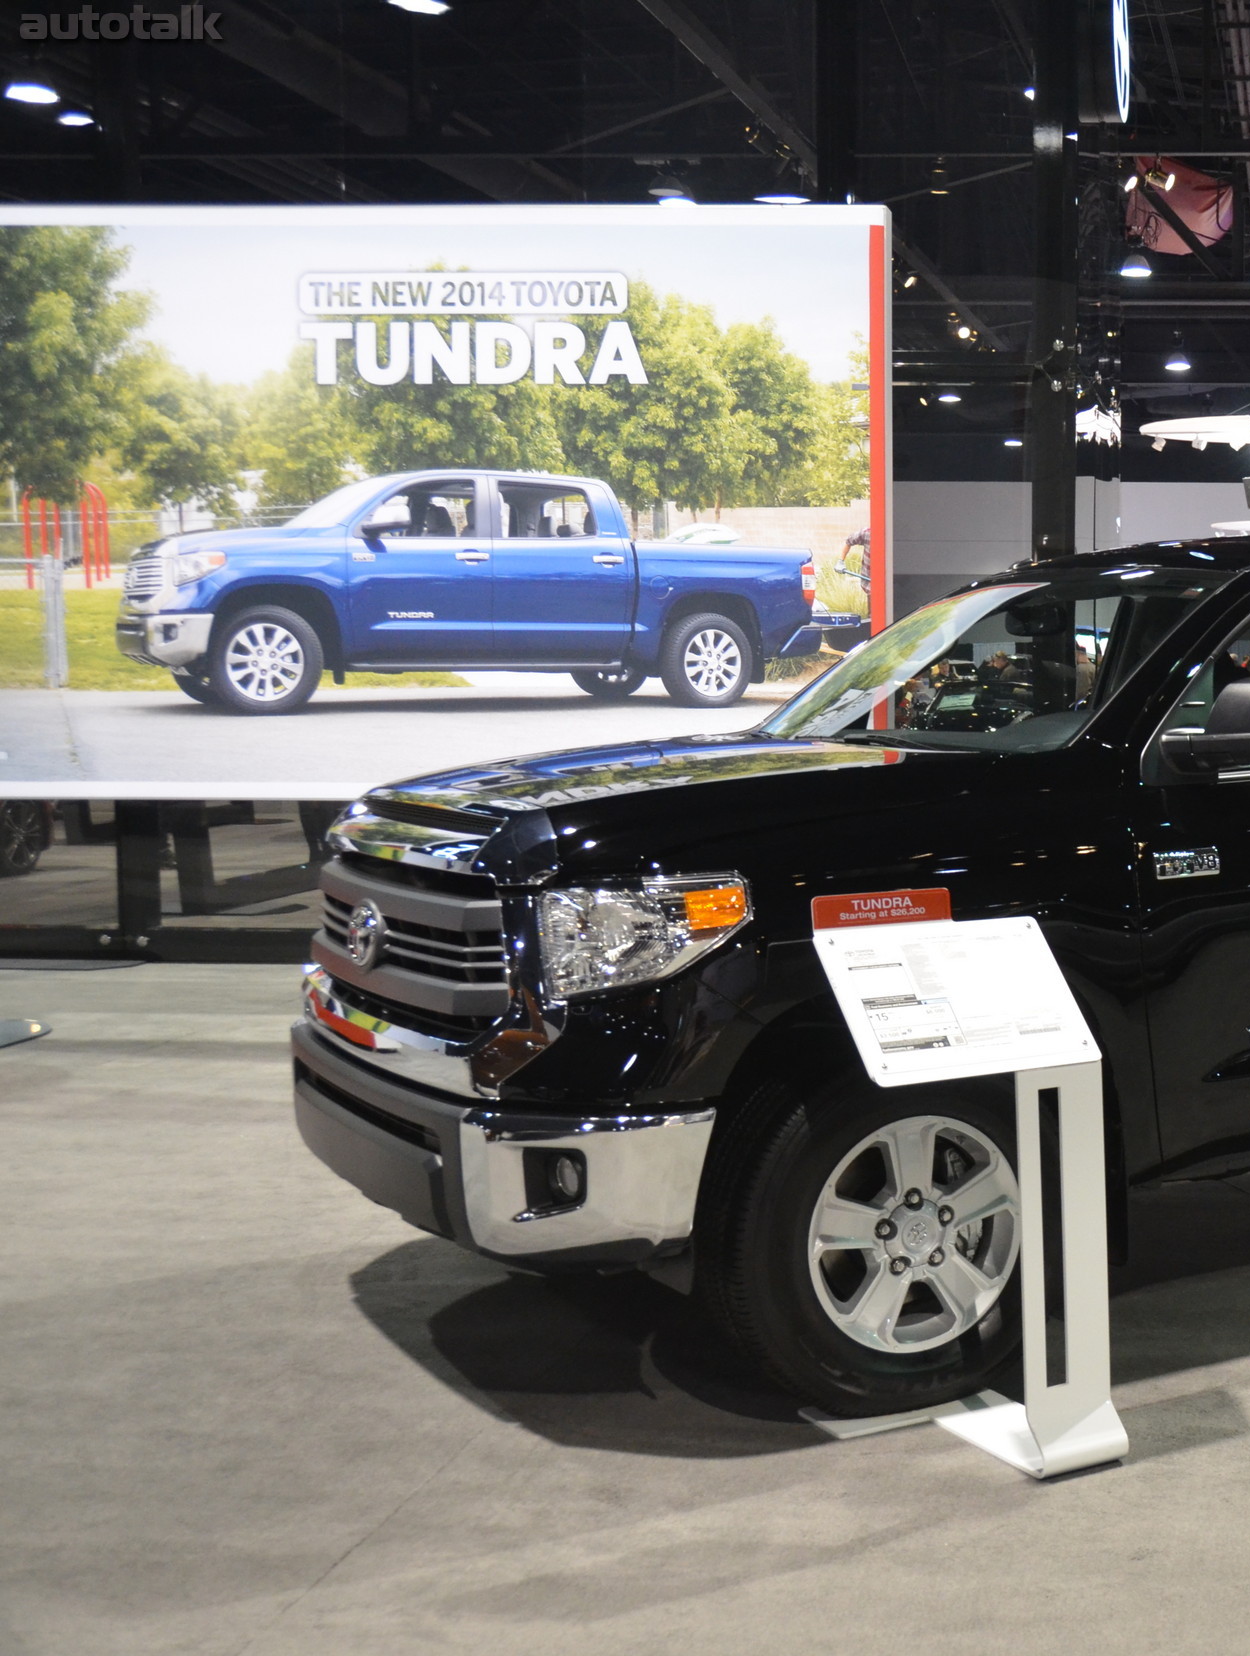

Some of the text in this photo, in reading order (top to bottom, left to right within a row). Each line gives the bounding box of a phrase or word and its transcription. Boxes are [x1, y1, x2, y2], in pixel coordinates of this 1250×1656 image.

[309, 281, 618, 307] THE NEW 2014 TOYOTA
[300, 321, 649, 386] TUNDRA
[839, 906, 926, 920] Starting at $26,200
[851, 896, 913, 911] TUNDRA
